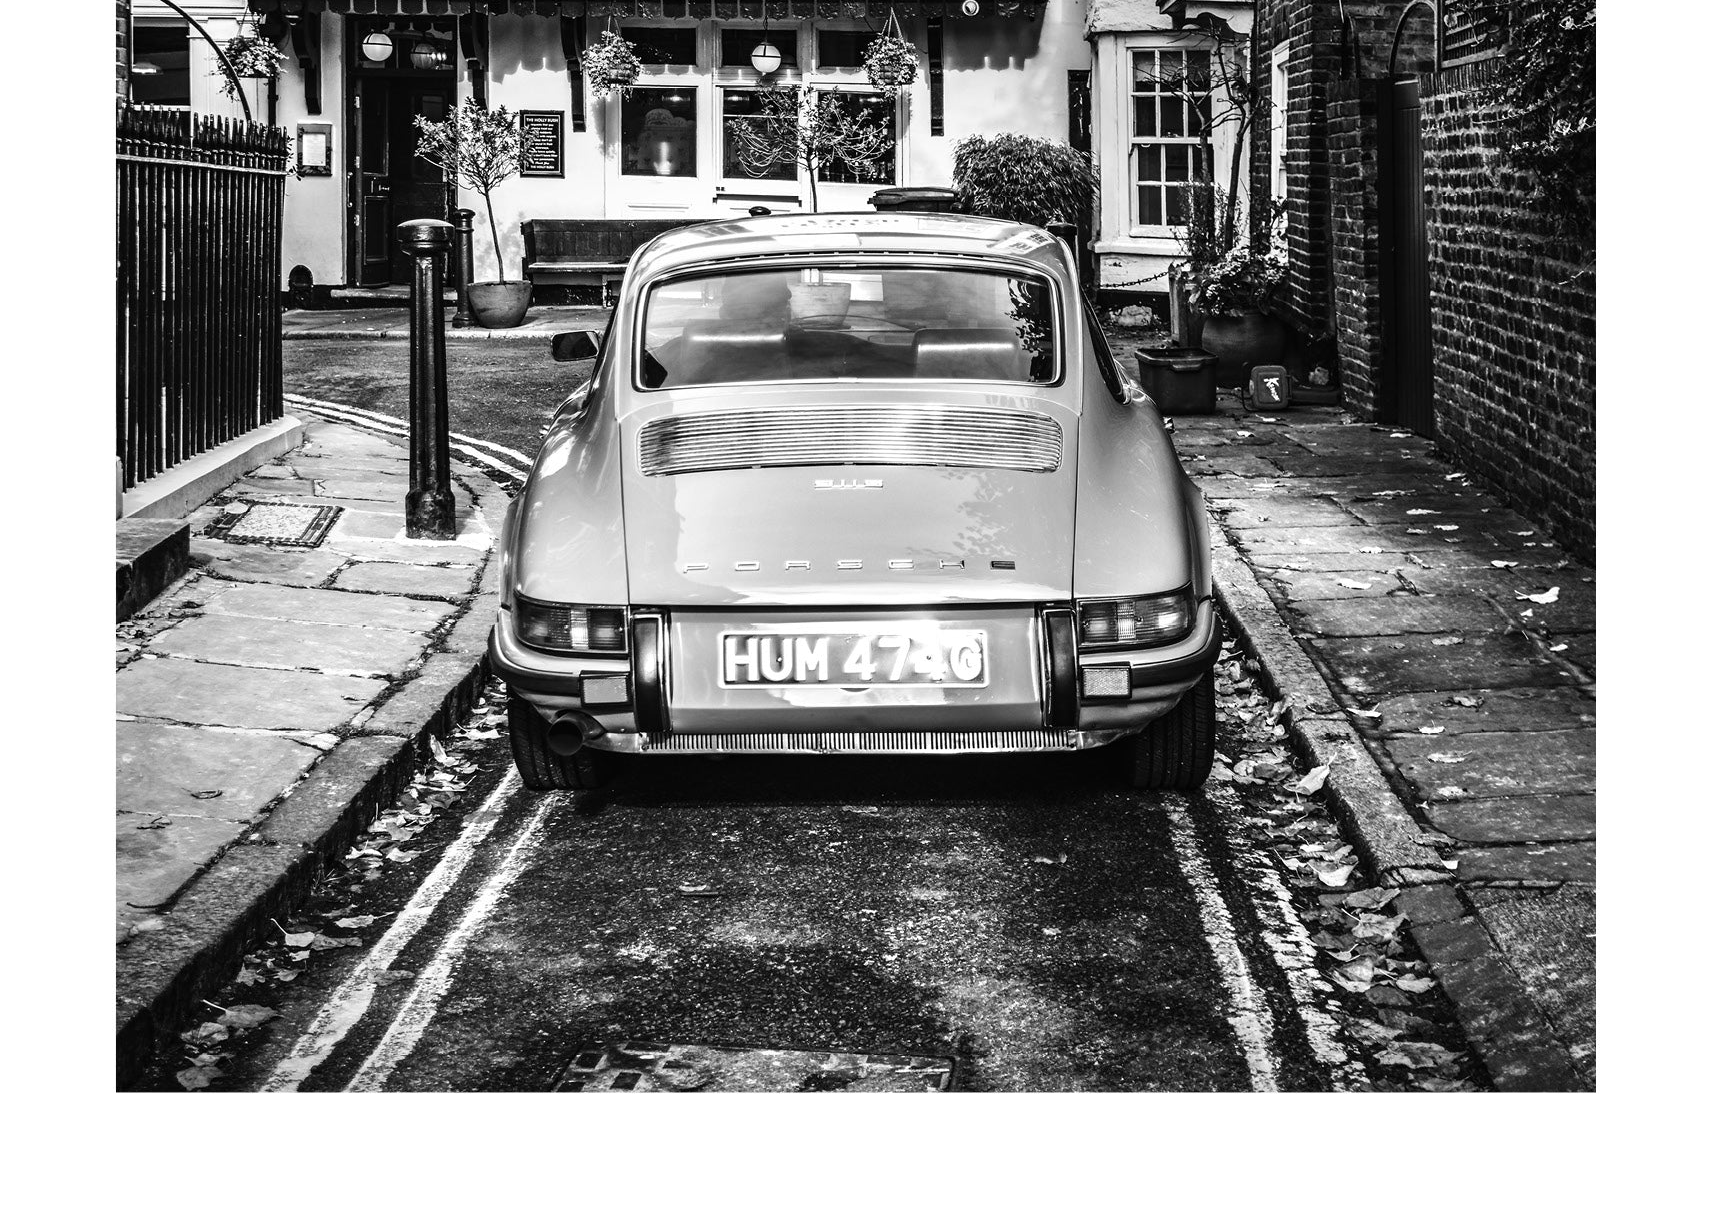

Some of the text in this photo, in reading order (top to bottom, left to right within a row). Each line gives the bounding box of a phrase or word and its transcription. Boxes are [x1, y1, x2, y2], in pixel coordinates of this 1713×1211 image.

[683, 559, 1016, 574] PORSCHE
[725, 635, 983, 682] HUM 474G
